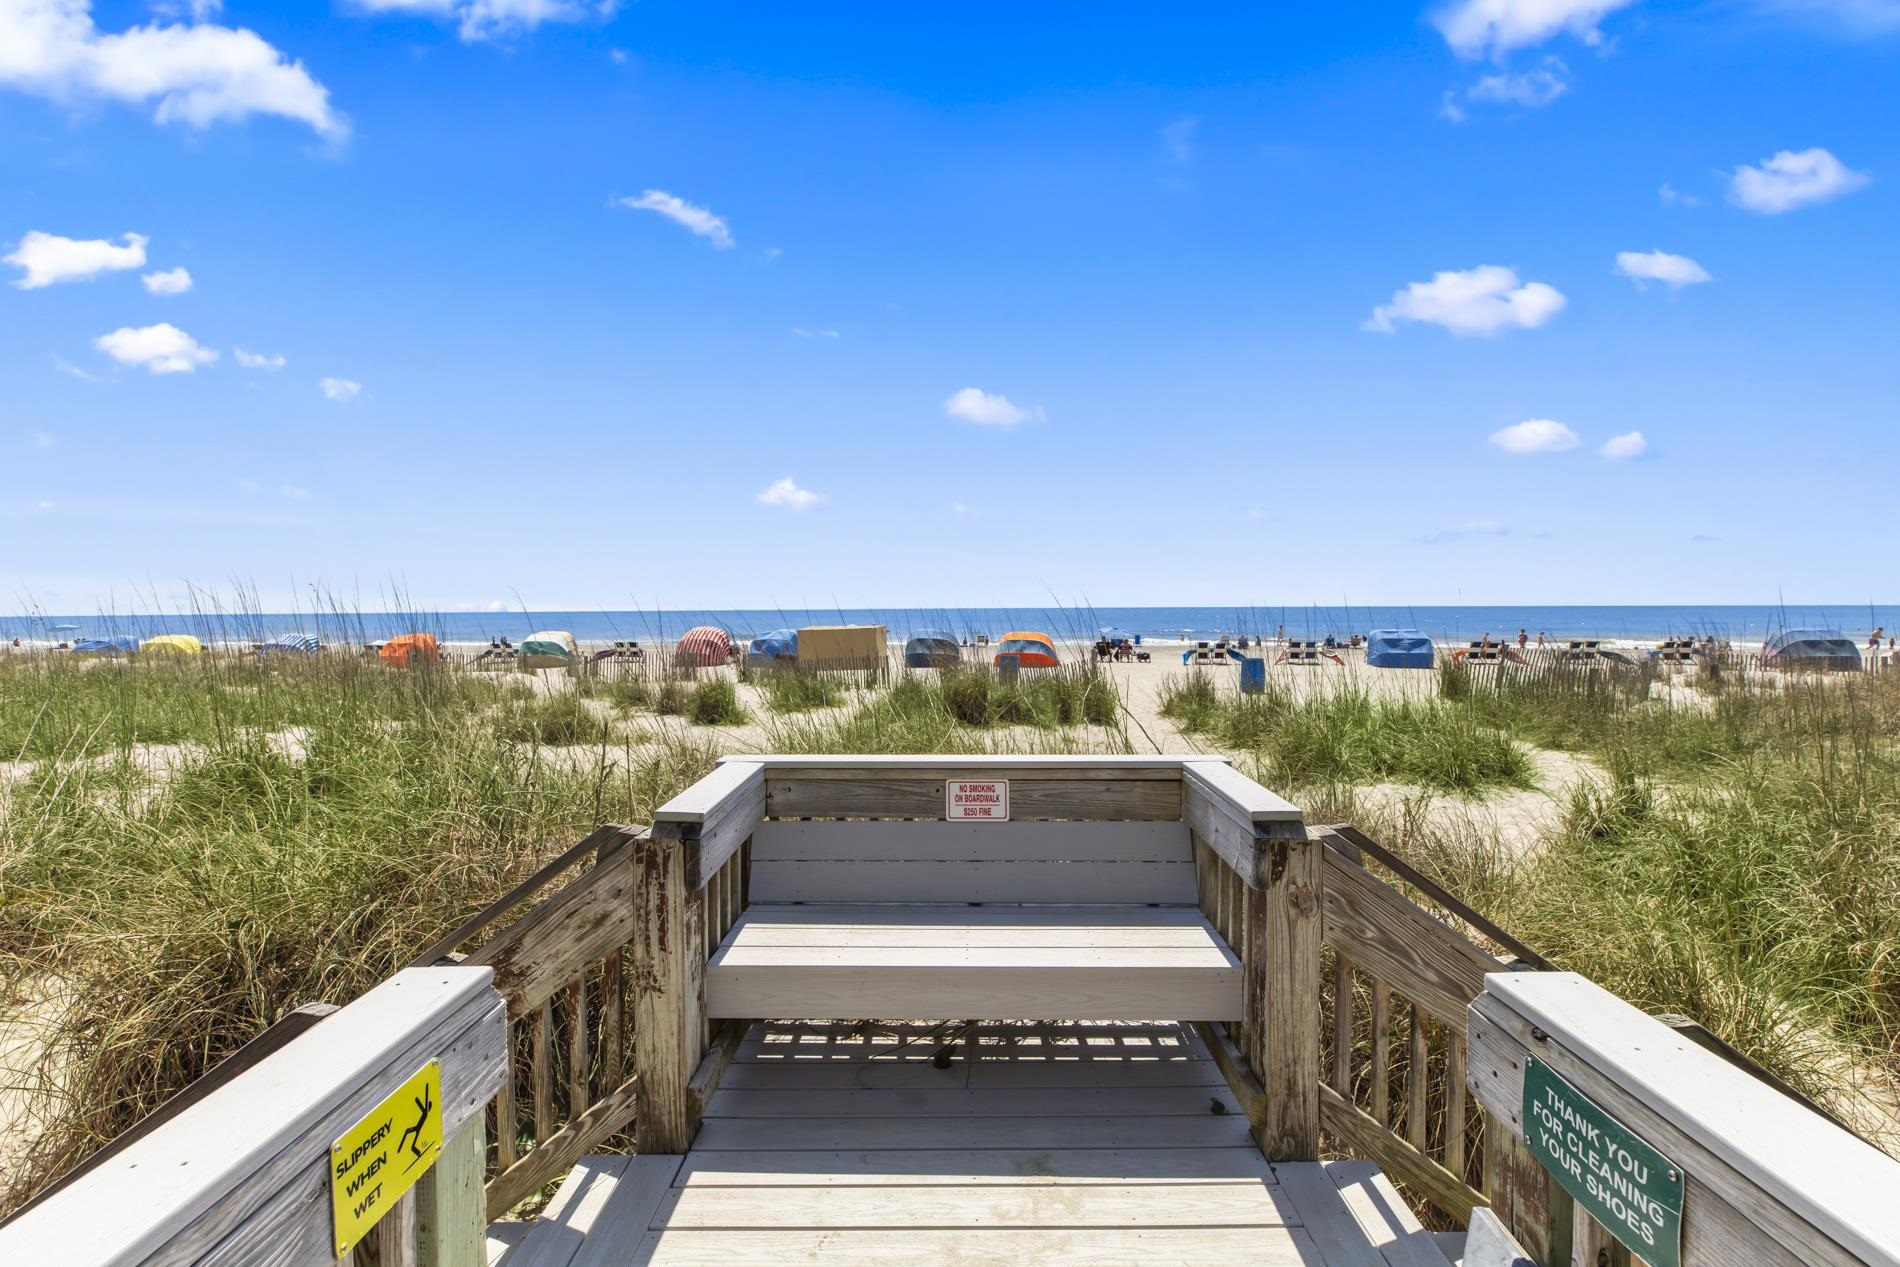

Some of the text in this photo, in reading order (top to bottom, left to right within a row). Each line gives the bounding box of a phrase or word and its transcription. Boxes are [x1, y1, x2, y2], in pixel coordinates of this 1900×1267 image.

[955, 795, 1000, 803] ON BOARDWALK
[959, 785, 995, 793] NO SMOKING
[964, 808, 991, 816] $250 FINE
[336, 1117, 393, 1180] SLIPPERY
[1545, 1086, 1648, 1185] THANK YOU
[345, 1151, 387, 1198] WHEN
[1533, 1099, 1664, 1227] FOR CLEANING
[1539, 1127, 1655, 1246] YOUR SHOES
[353, 1182, 383, 1220] WET
